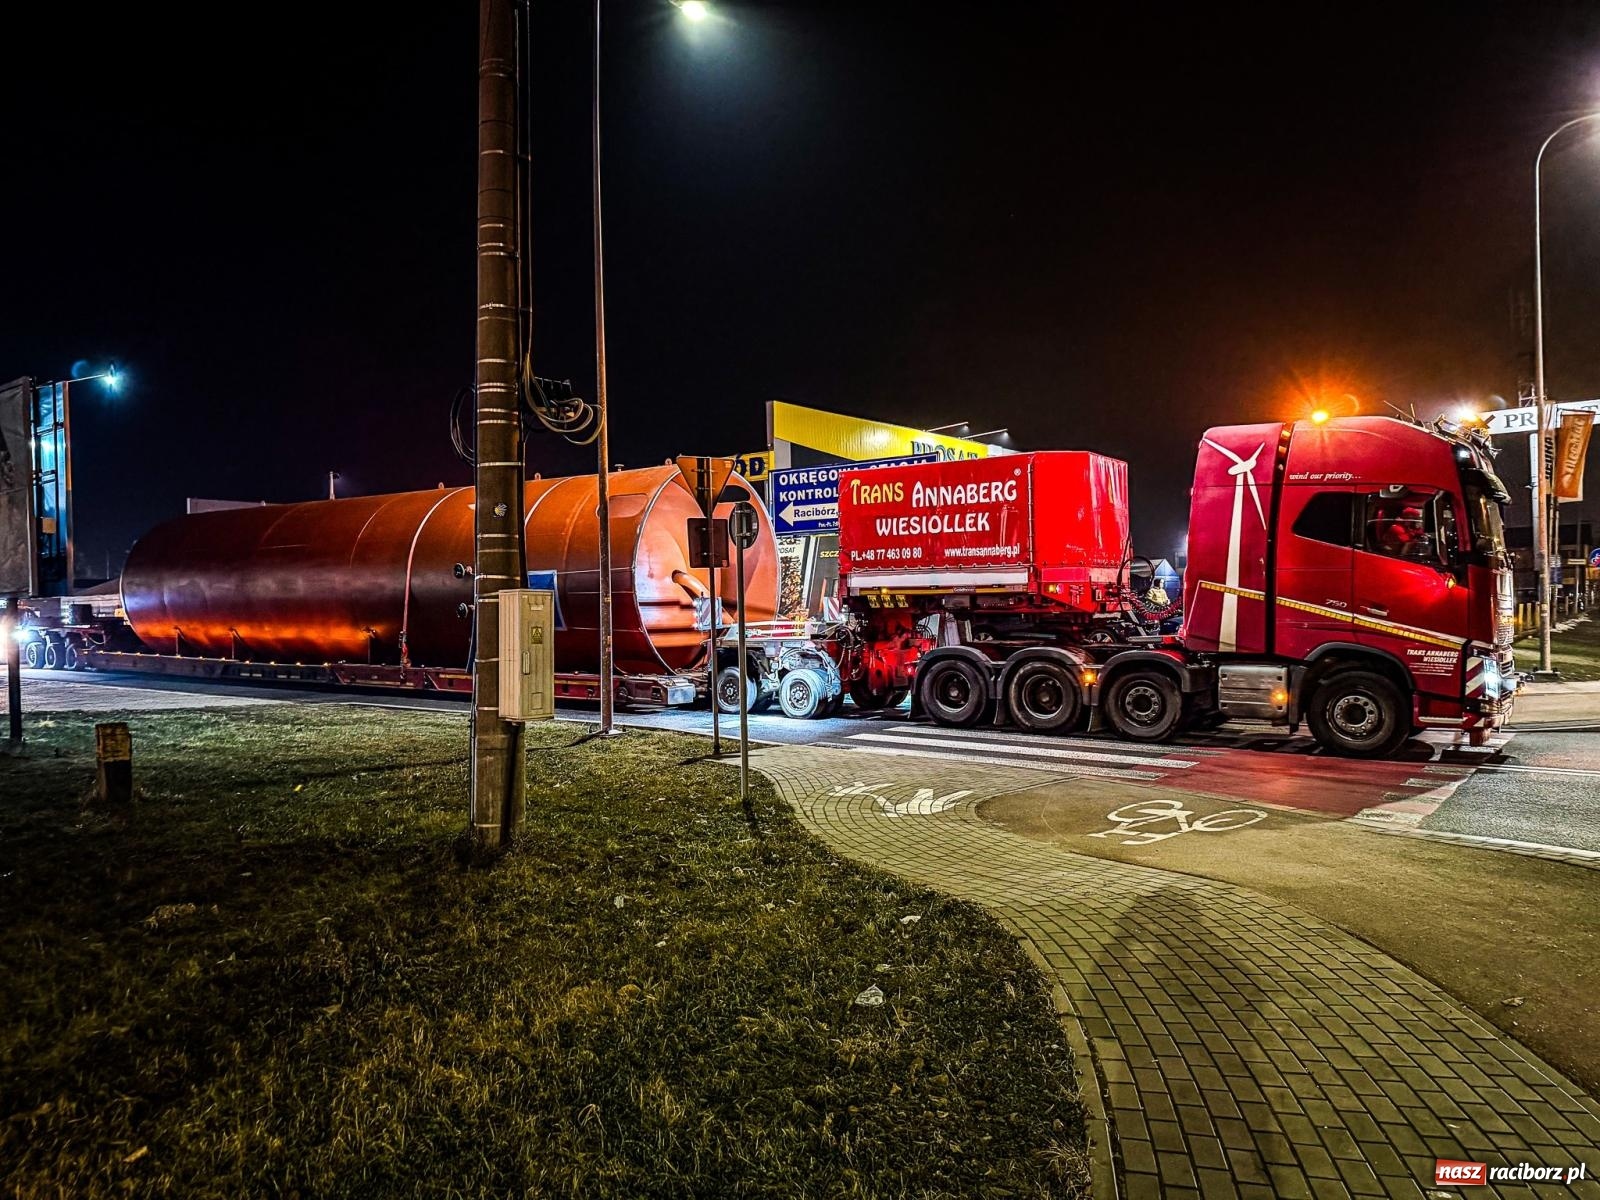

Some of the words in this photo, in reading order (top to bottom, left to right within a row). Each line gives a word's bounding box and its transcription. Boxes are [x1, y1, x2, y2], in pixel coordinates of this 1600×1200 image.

[778, 467, 859, 486] OKRĘGO
[1289, 472, 1309, 480] wind
[851, 478, 904, 505] TRANS
[912, 480, 1017, 508] ANNABERG
[875, 512, 990, 537] WIESIOLLEK
[876, 549, 885, 560] 77
[886, 548, 900, 560] 463
[901, 548, 911, 559] 09
[912, 547, 922, 559] 80
[944, 543, 1020, 558] www.transannaberg.pl
